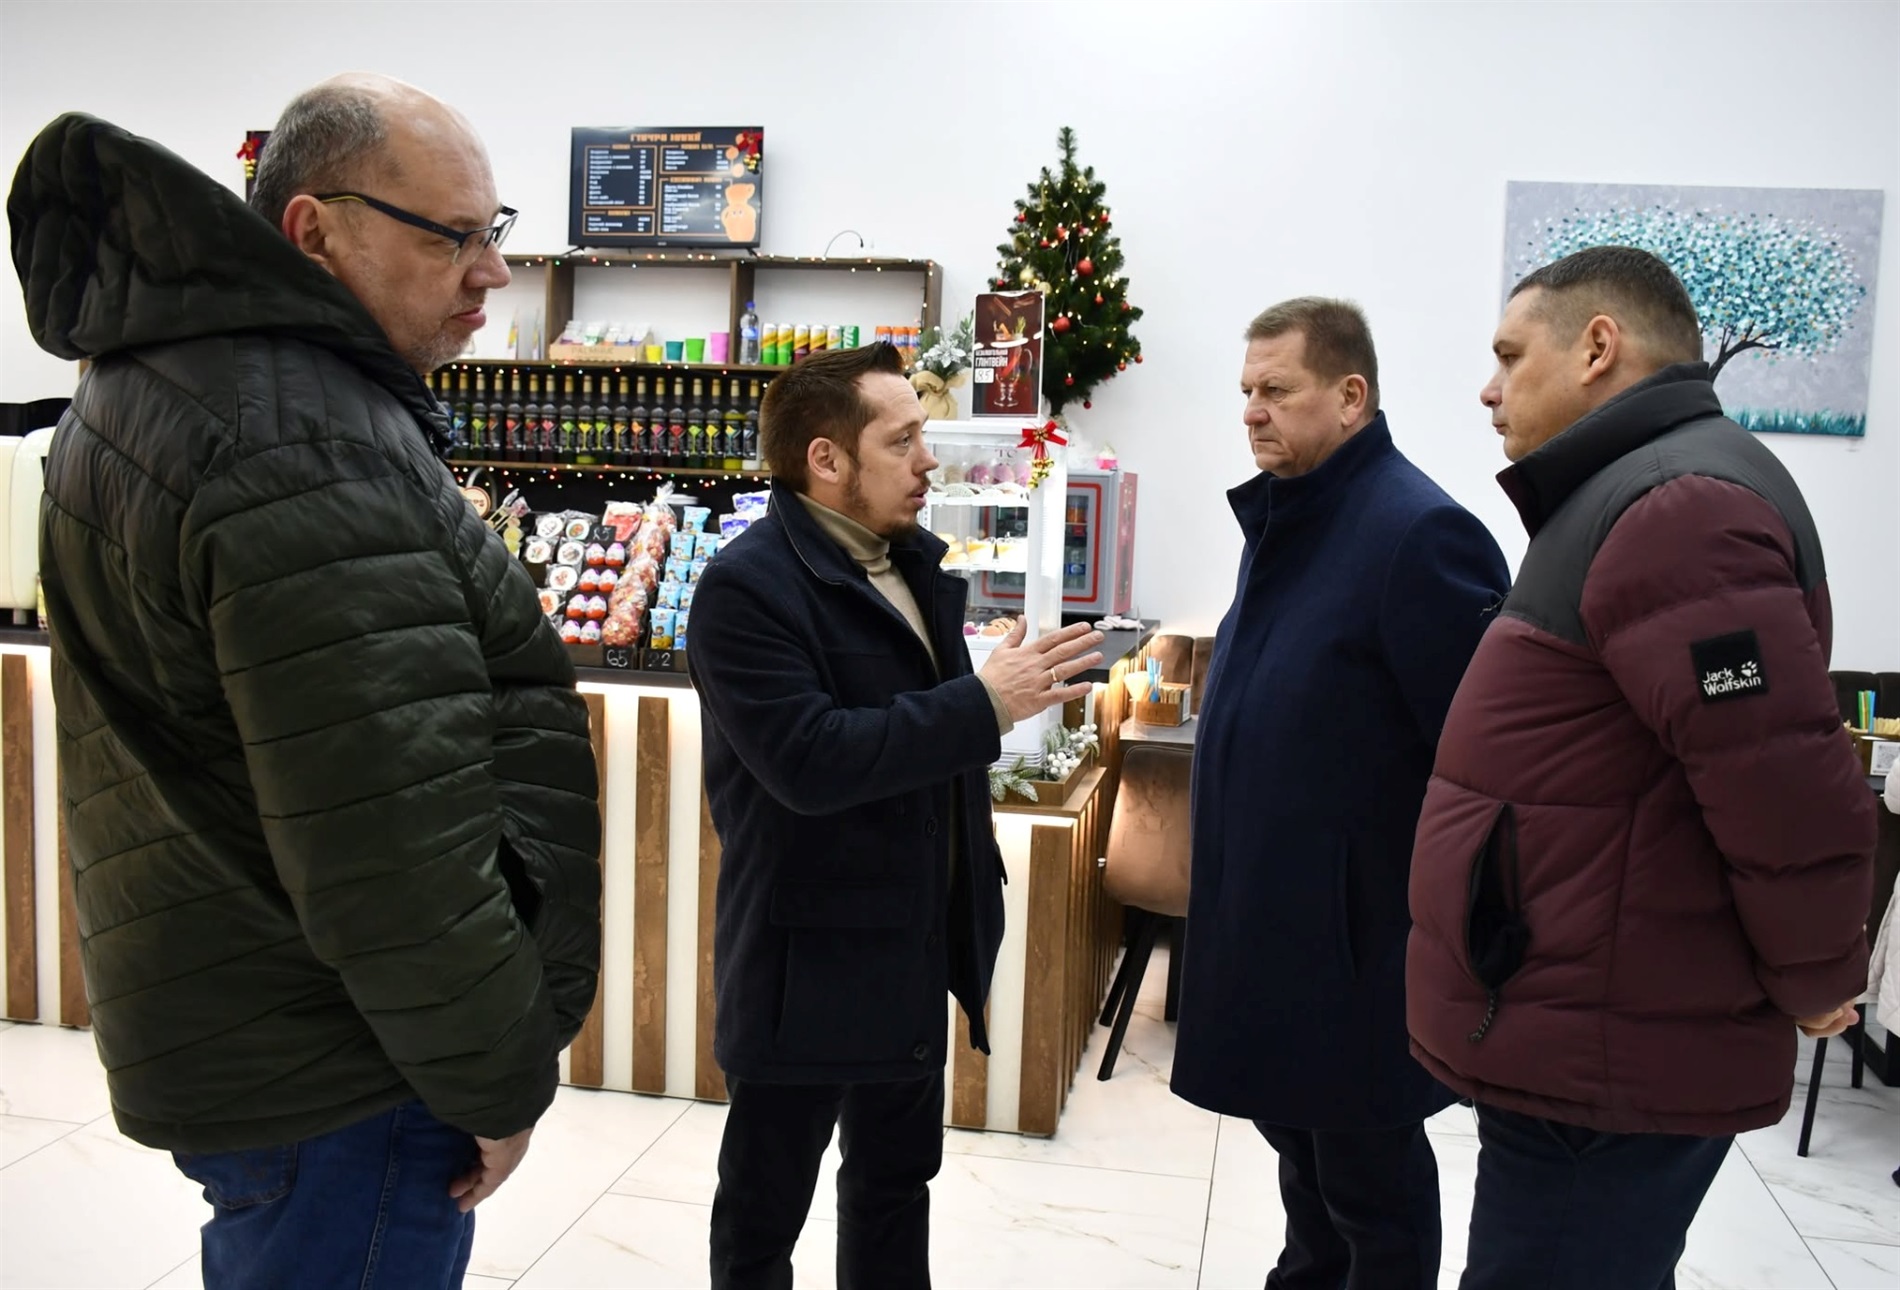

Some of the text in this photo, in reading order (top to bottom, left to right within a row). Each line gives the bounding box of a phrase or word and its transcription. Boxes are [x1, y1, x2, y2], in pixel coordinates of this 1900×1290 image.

[606, 649, 628, 668] 65
[1702, 667, 1735, 684] Jack
[1703, 676, 1762, 696] Wolfskin
